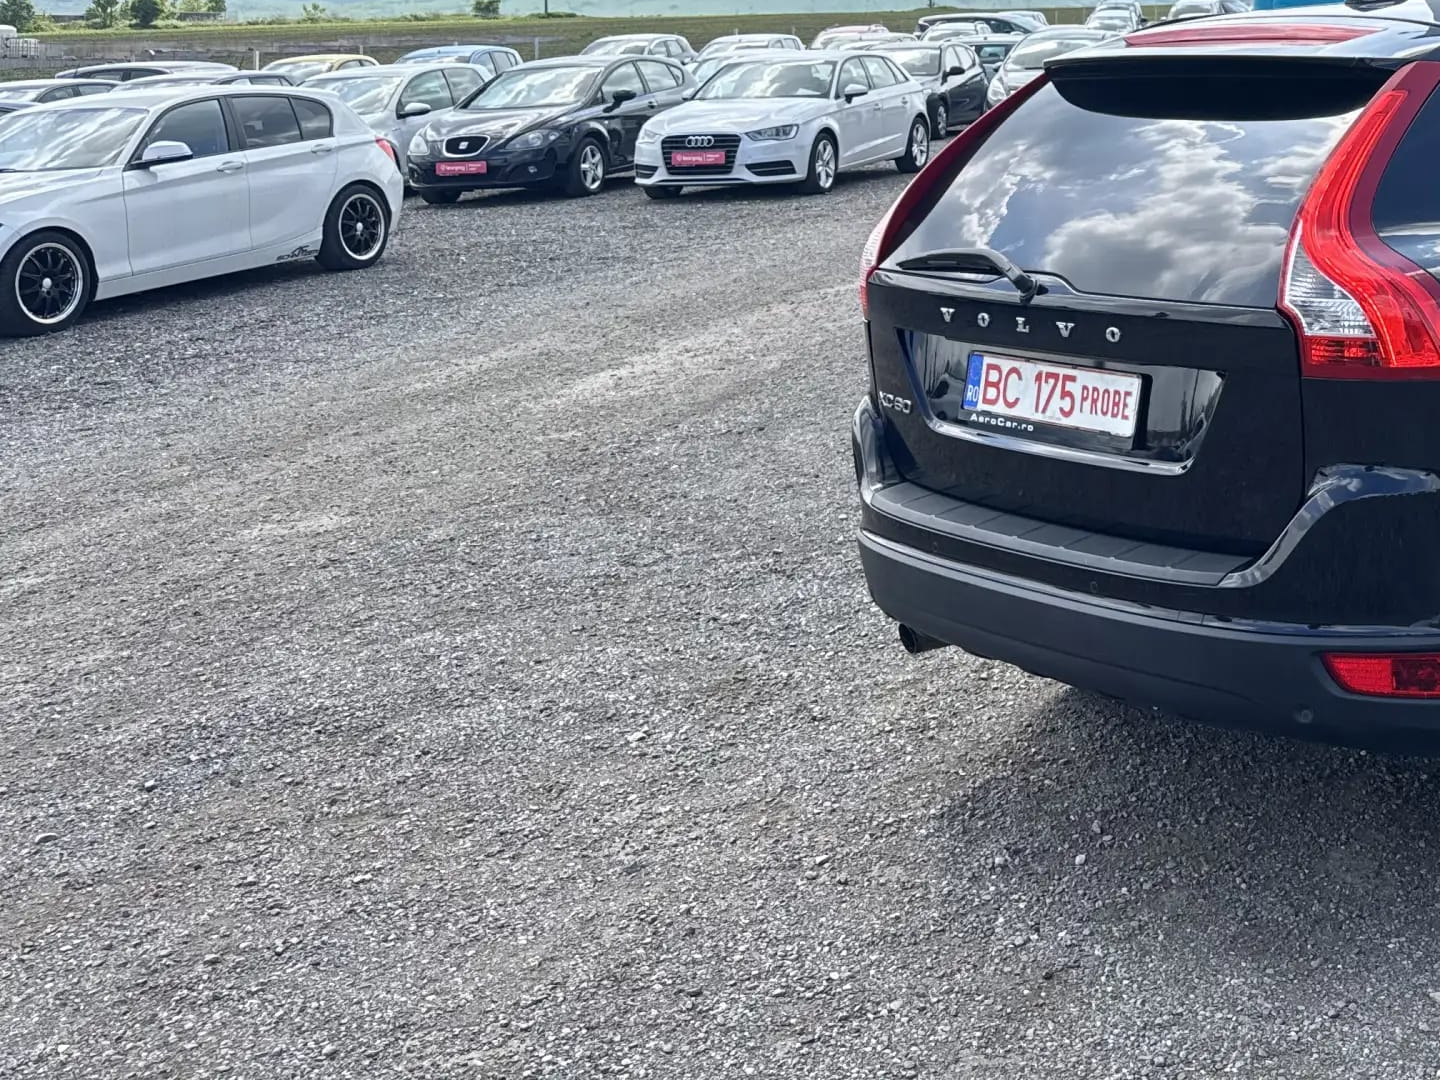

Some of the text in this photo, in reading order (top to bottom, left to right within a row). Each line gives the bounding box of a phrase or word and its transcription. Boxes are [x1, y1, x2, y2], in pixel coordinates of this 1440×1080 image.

[940, 307, 1121, 343] VOLVO
[966, 384, 980, 403] RO
[982, 363, 1133, 421] BC 175 PROBE
[970, 413, 1034, 432] AeroCar.ro
